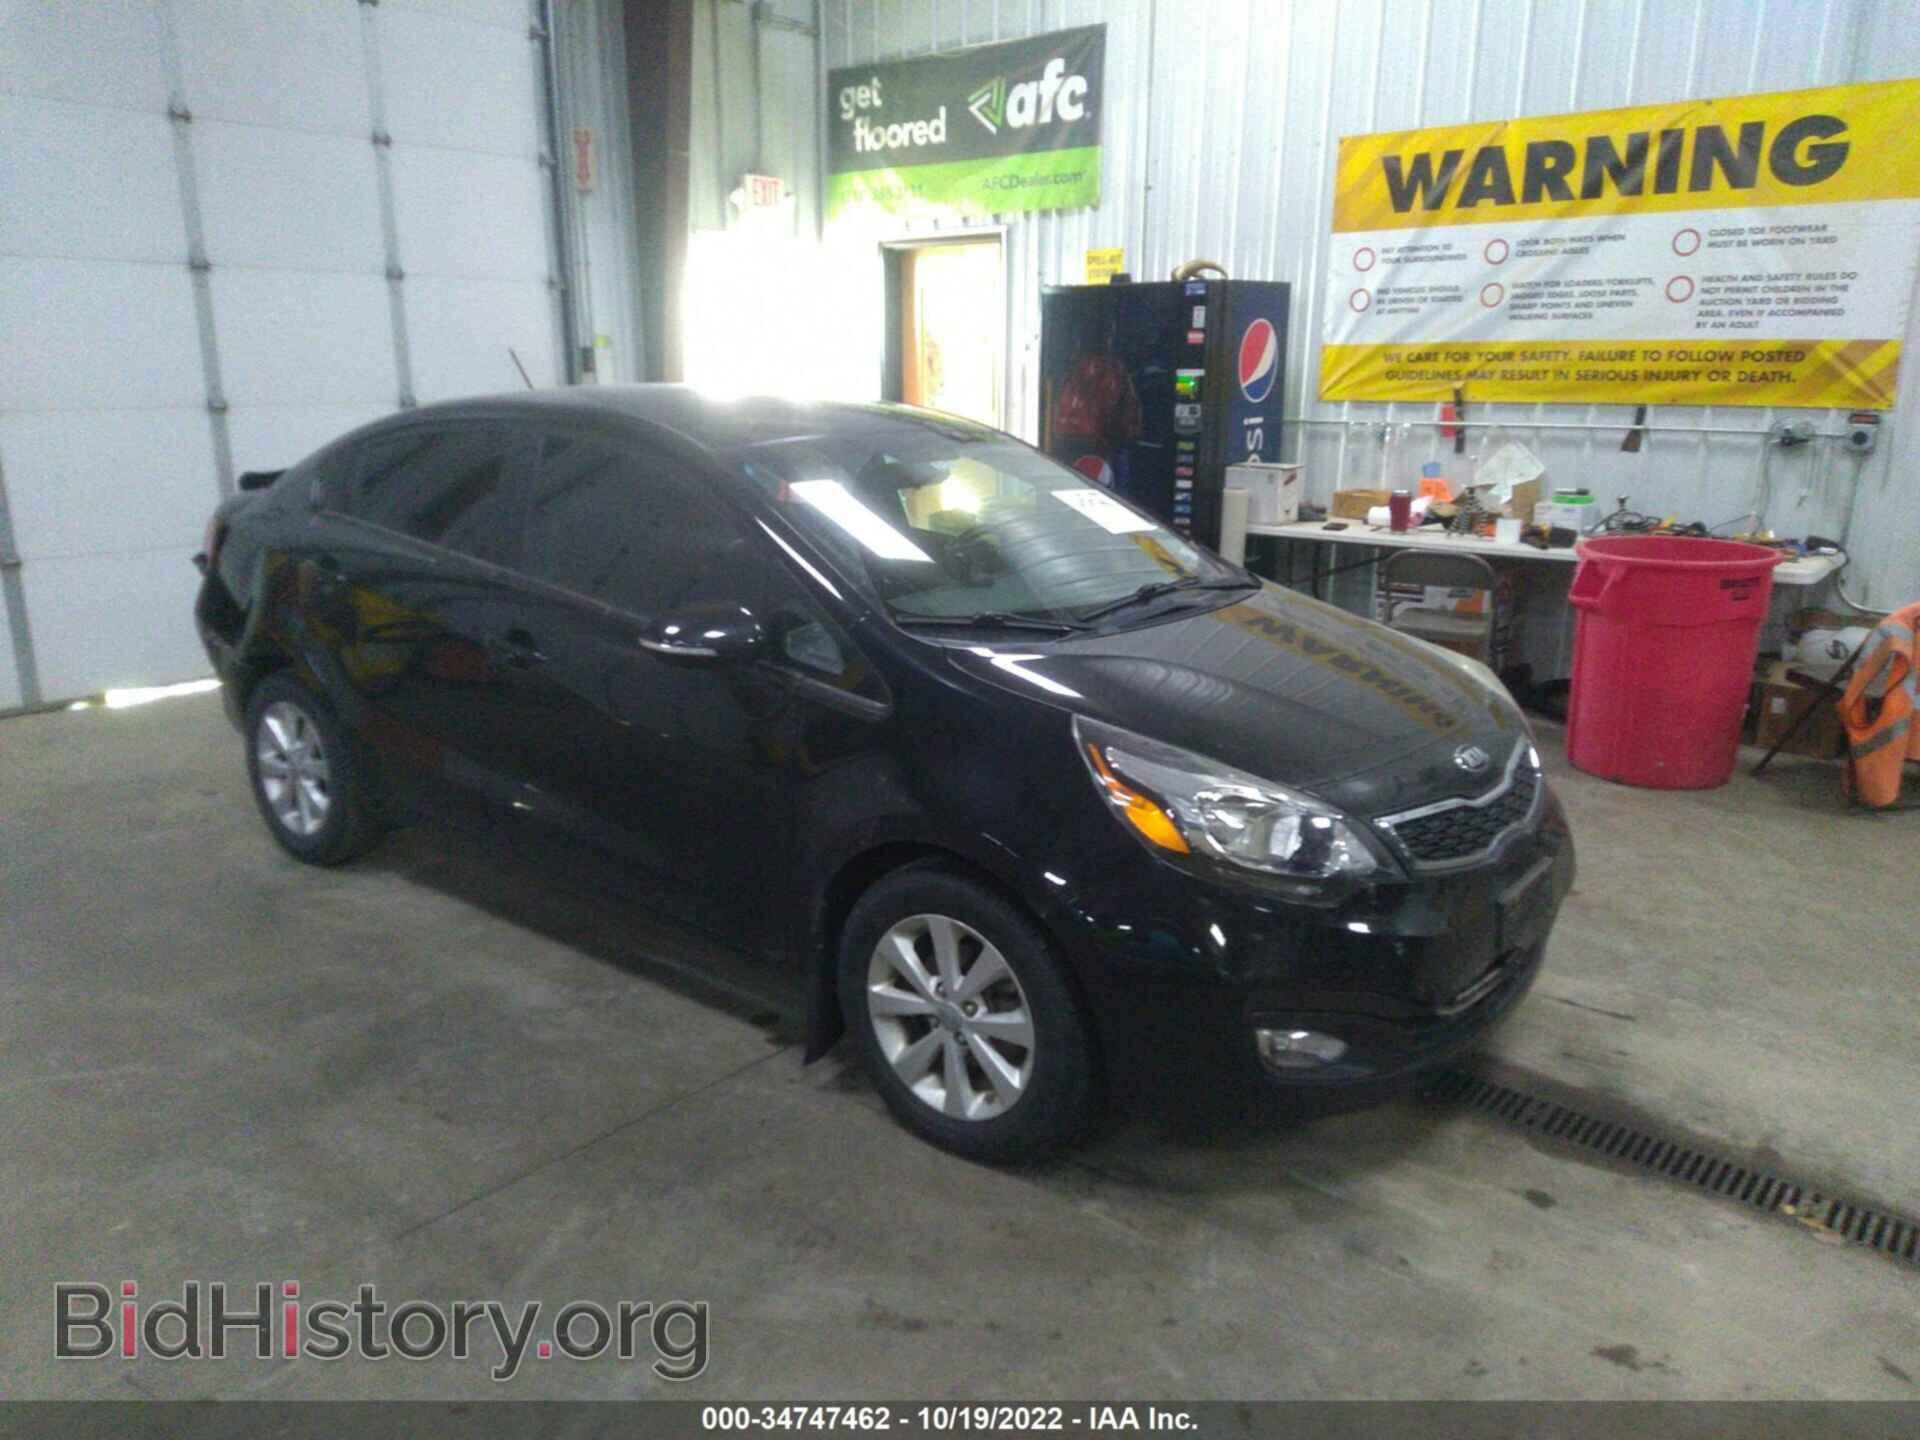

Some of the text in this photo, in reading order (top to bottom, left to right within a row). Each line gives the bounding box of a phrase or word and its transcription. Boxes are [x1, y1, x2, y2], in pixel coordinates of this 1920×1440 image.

[840, 76, 882, 120] get
[1006, 58, 1088, 128] afc
[854, 105, 946, 152] floored
[1381, 113, 1851, 214] WARNING
[753, 177, 780, 207] EXIT
[1708, 228, 1745, 237] CLOSED
[1769, 224, 1828, 234] FOOTWEAR
[1707, 236, 1838, 248] MUST BE WORN ON YARD
[1741, 274, 1764, 282] AND
[1766, 273, 1803, 282] SAFETY
[1806, 272, 1837, 281] RULES
[1840, 271, 1858, 280] DO
[1700, 283, 1849, 295] NOT PERMIT CHILDREN IN THE
[1728, 309, 1753, 318] EVEN
[1768, 307, 1846, 317] ACCOMPANIED
[1695, 319, 1760, 329] BY AN ADULT
[1384, 352, 1400, 363] WE
[1407, 351, 1439, 363] CARE
[1443, 351, 1471, 362] FOR
[1477, 351, 1515, 362] YOUR
[1578, 350, 1637, 363] FAILURE
[1642, 351, 1662, 362] TO
[1667, 350, 1734, 363] FOLLOW
[1741, 350, 1807, 363] POSTED
[1385, 369, 1797, 383] GUIDELINES MAY RESULT IN SERIOUS INJURY OR DEATH.
